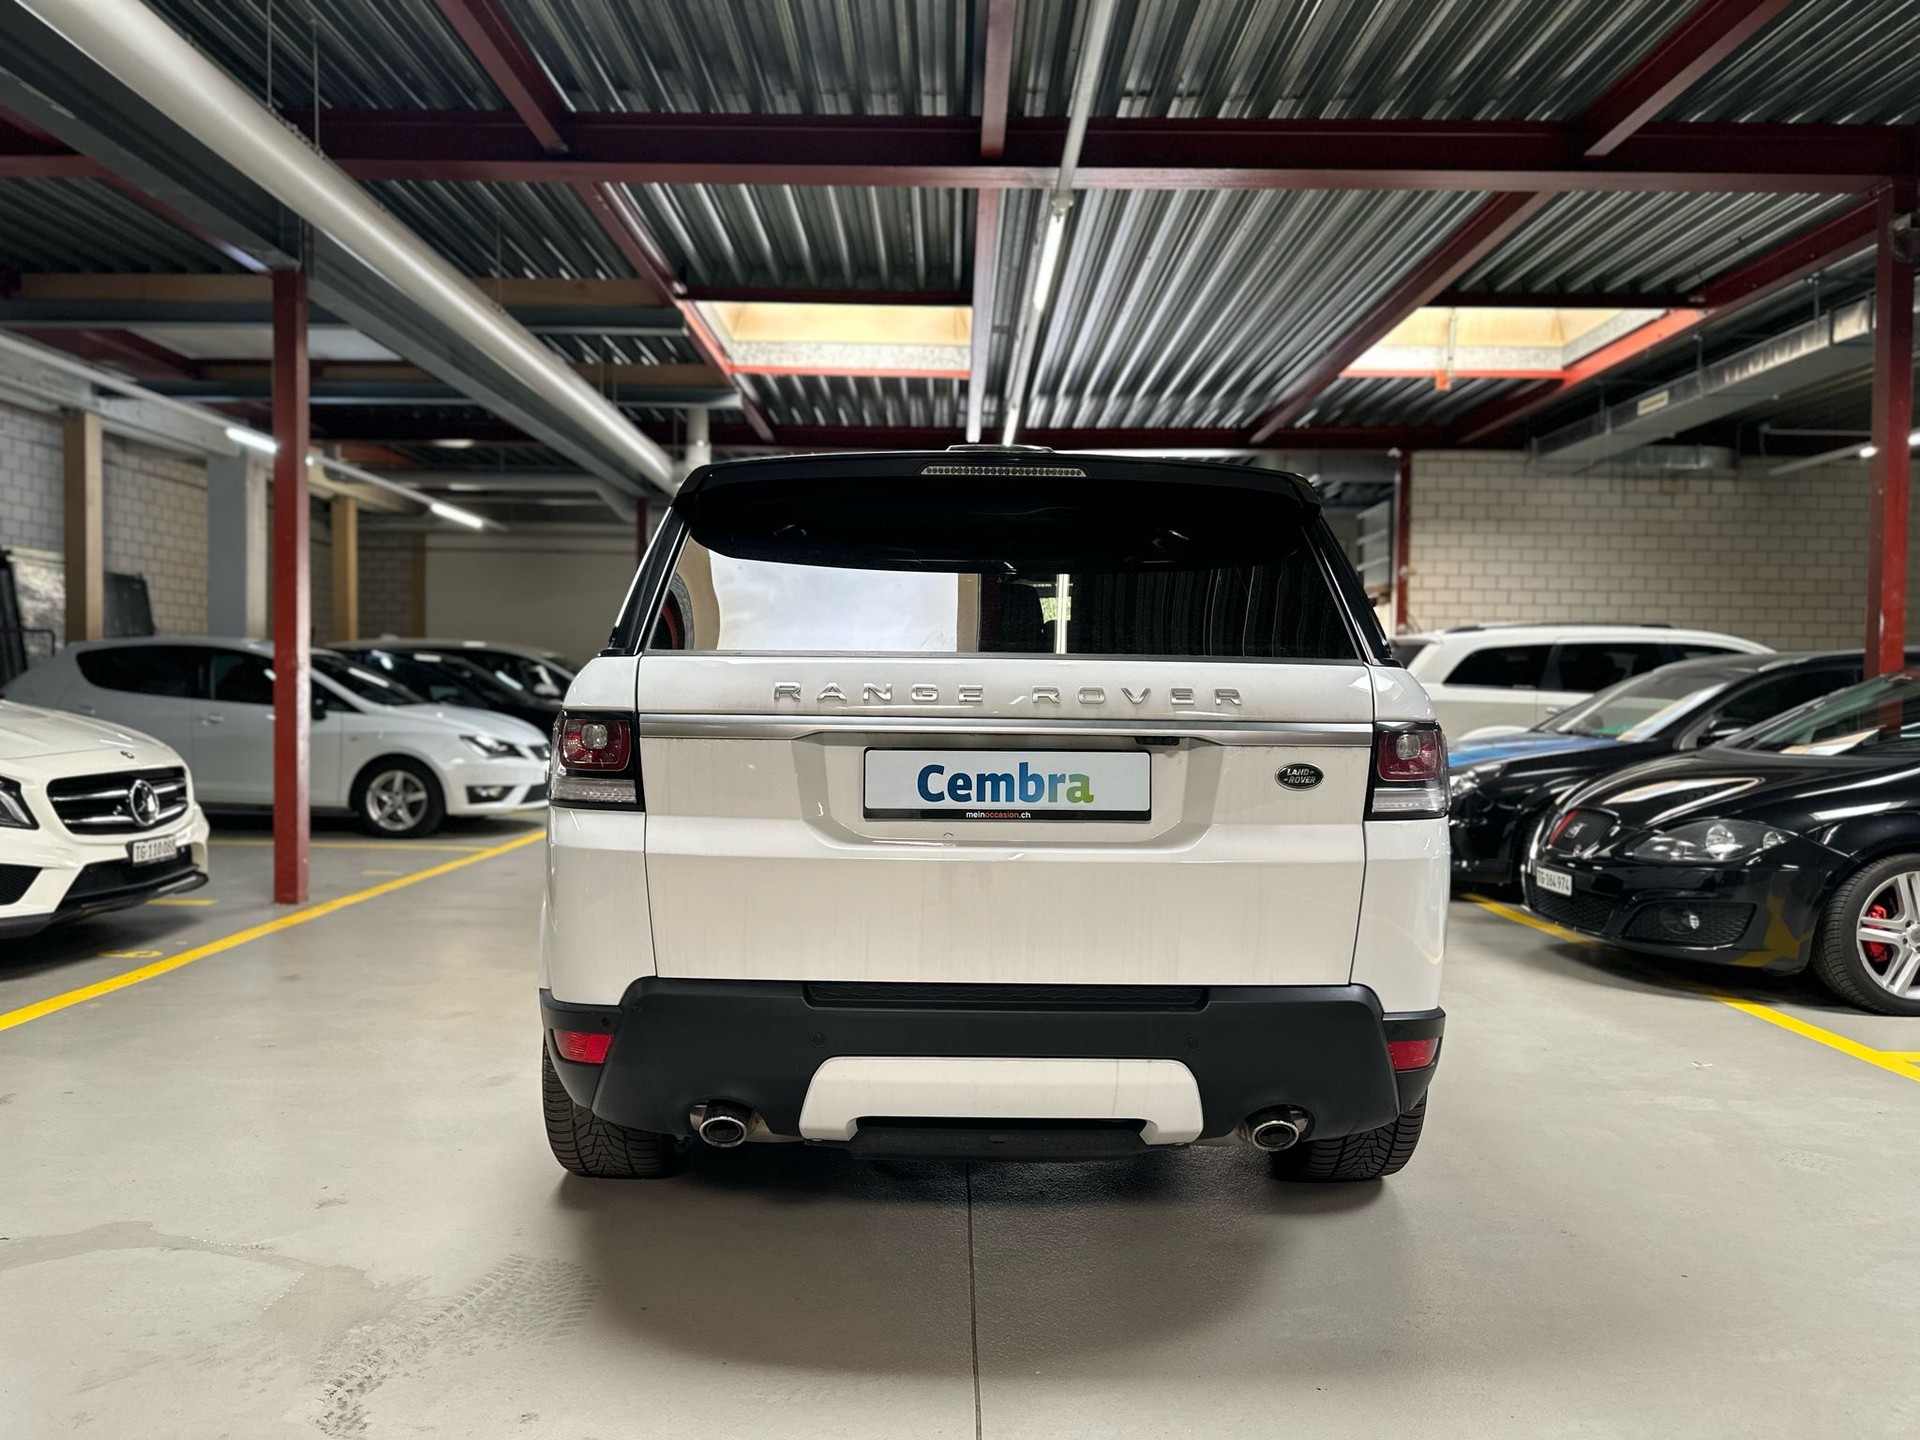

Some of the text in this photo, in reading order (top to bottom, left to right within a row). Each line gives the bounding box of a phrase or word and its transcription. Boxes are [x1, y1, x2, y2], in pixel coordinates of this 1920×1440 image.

[773, 681, 1242, 706] RANGE ROVER
[917, 761, 1095, 804] Cembra
[965, 810, 1031, 819] meinoccasion.ch
